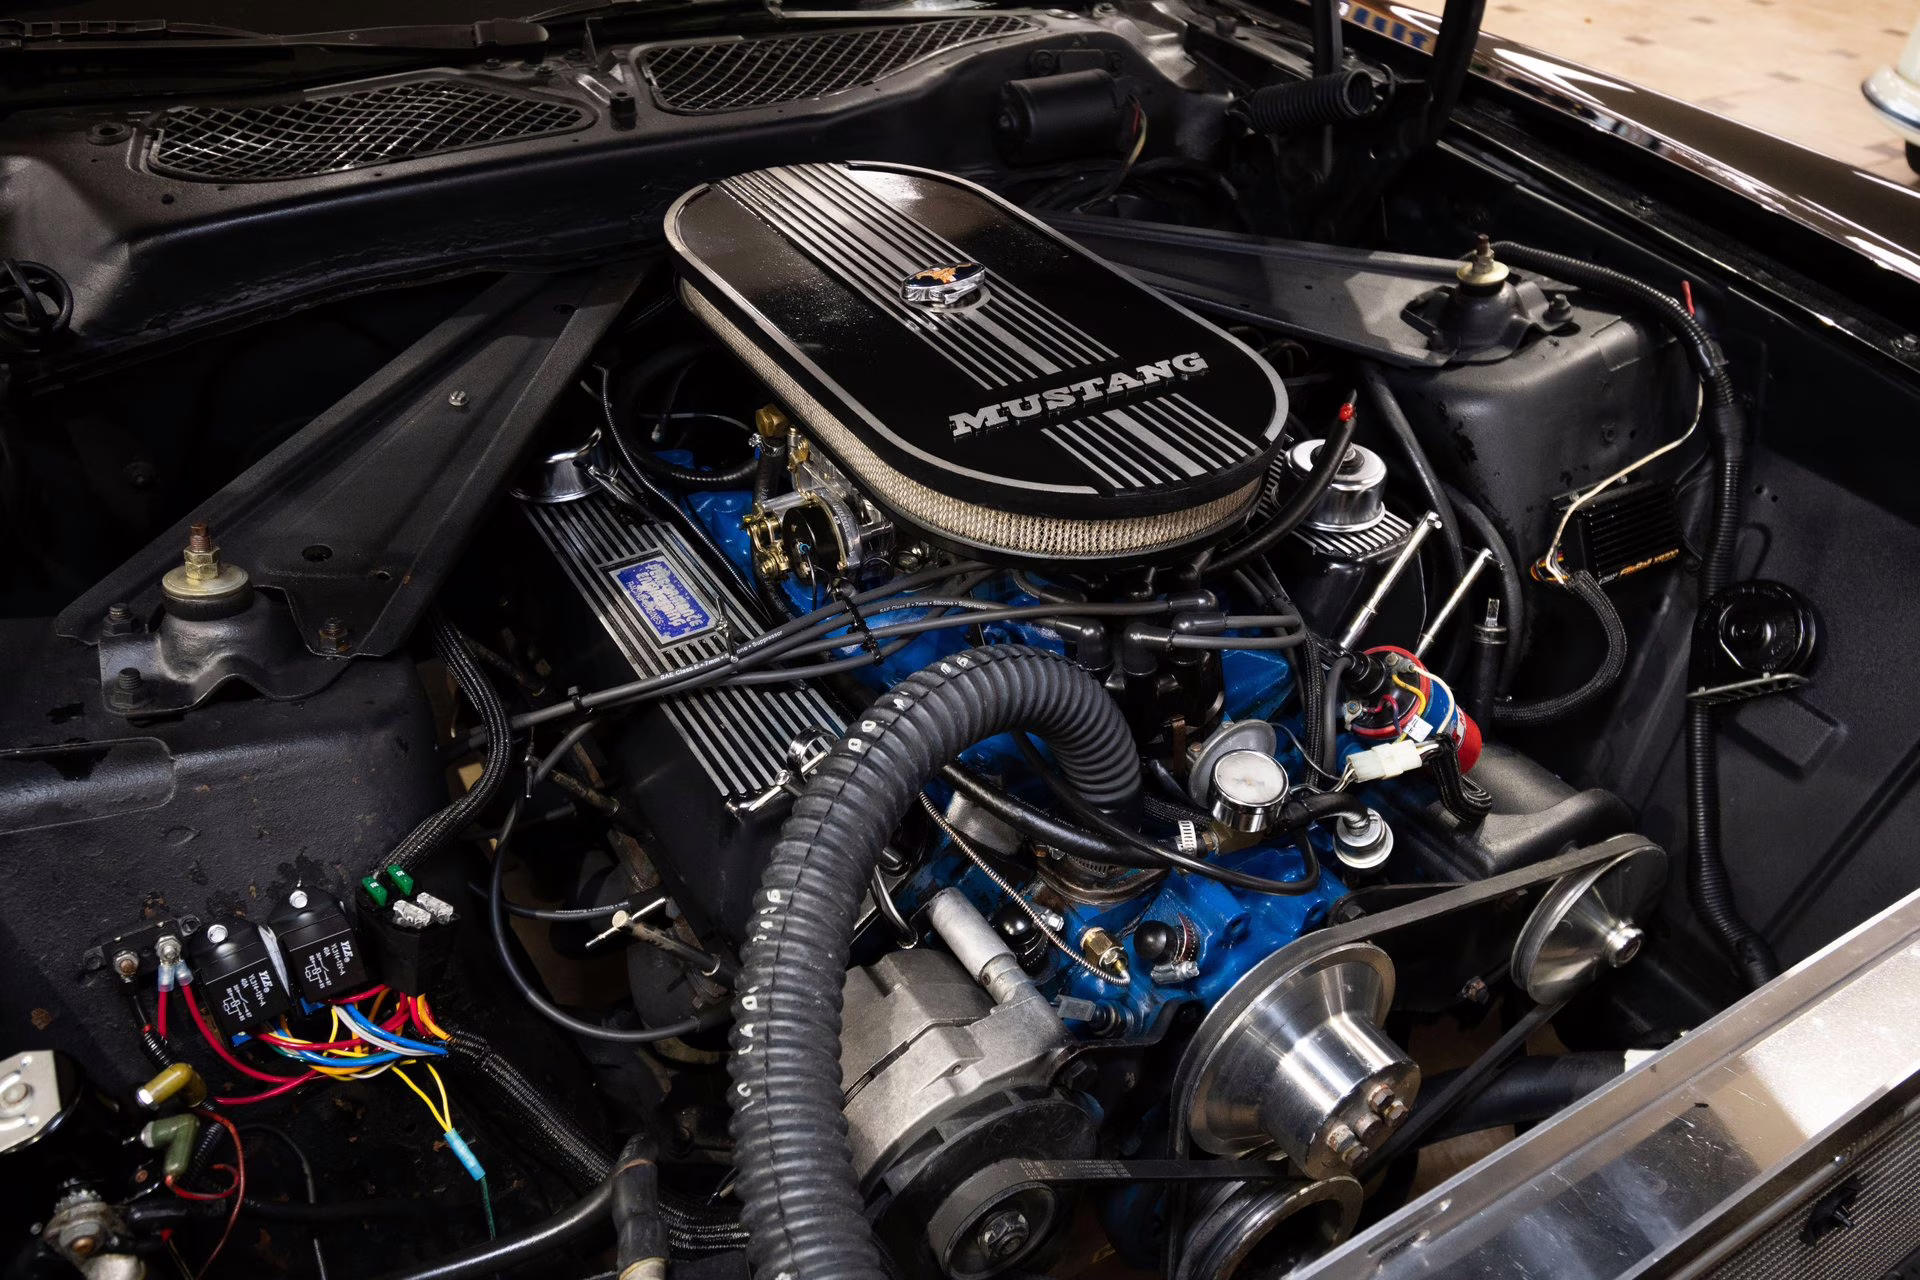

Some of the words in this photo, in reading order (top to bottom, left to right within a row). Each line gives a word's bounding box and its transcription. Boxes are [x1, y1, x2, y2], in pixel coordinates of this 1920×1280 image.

[949, 352, 1208, 436] MUSTANG
[660, 672, 673, 680] SAE
[675, 666, 693, 675] Class
[704, 657, 720, 665] 7mm
[751, 630, 783, 647] Suppressor
[322, 946, 330, 956] 40A
[329, 942, 345, 975] YL314-12V-A
[340, 940, 353, 957] YLE
[239, 977, 249, 988] 40A
[248, 973, 266, 1006] YL314-12V-A
[259, 970, 273, 987] YLE
